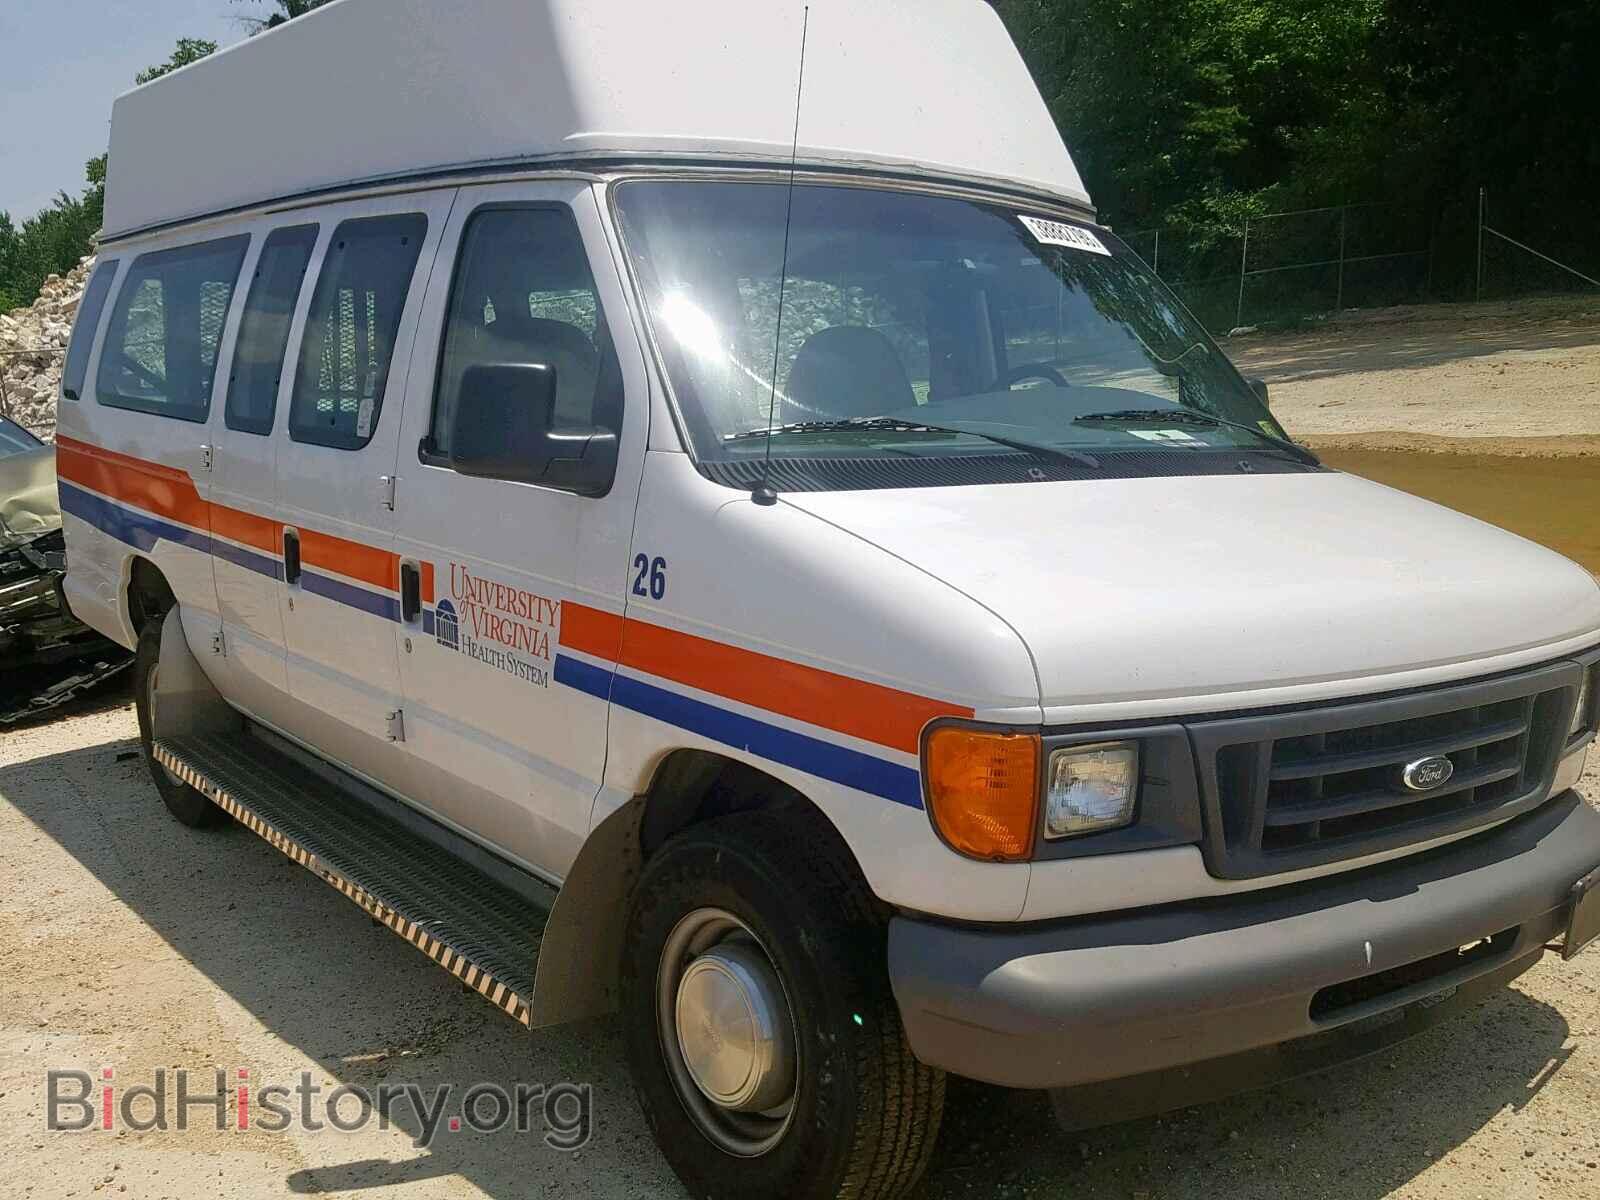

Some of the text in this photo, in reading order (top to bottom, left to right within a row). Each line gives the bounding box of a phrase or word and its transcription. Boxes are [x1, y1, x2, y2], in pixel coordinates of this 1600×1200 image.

[450, 562, 560, 627] UNIVERSITY
[632, 553, 667, 600] 26
[468, 601, 550, 661] VIRGINIA
[461, 634, 548, 688] HEALTH SYSTEM
[1418, 763, 1444, 784] Ford
